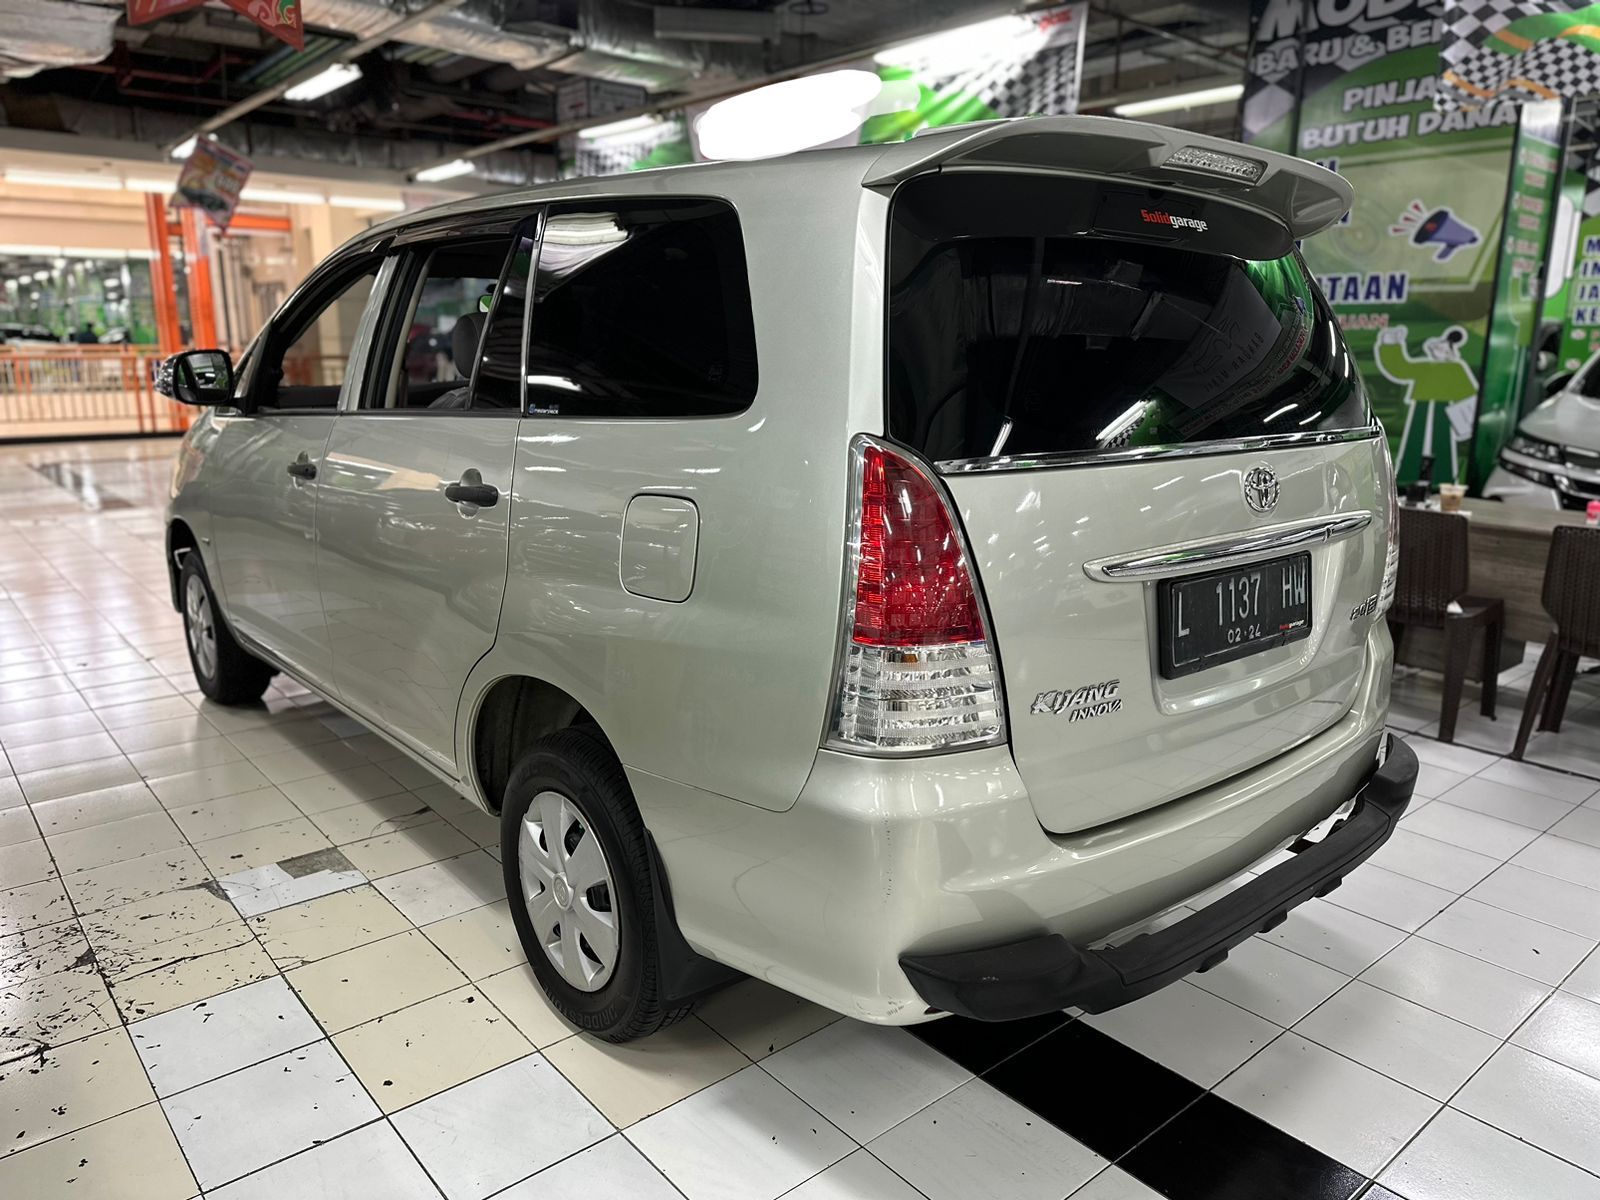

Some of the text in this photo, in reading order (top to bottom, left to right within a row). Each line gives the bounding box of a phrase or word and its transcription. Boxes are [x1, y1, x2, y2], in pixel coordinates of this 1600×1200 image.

[1342, 75, 1441, 112] PINJA
[1302, 103, 1518, 150] BUTUH DANA
[1140, 209, 1208, 231] Solidgarage
[1317, 273, 1406, 301] TAAN
[1178, 562, 1306, 637] L 1137 HW
[1030, 679, 1120, 715] KIJANG
